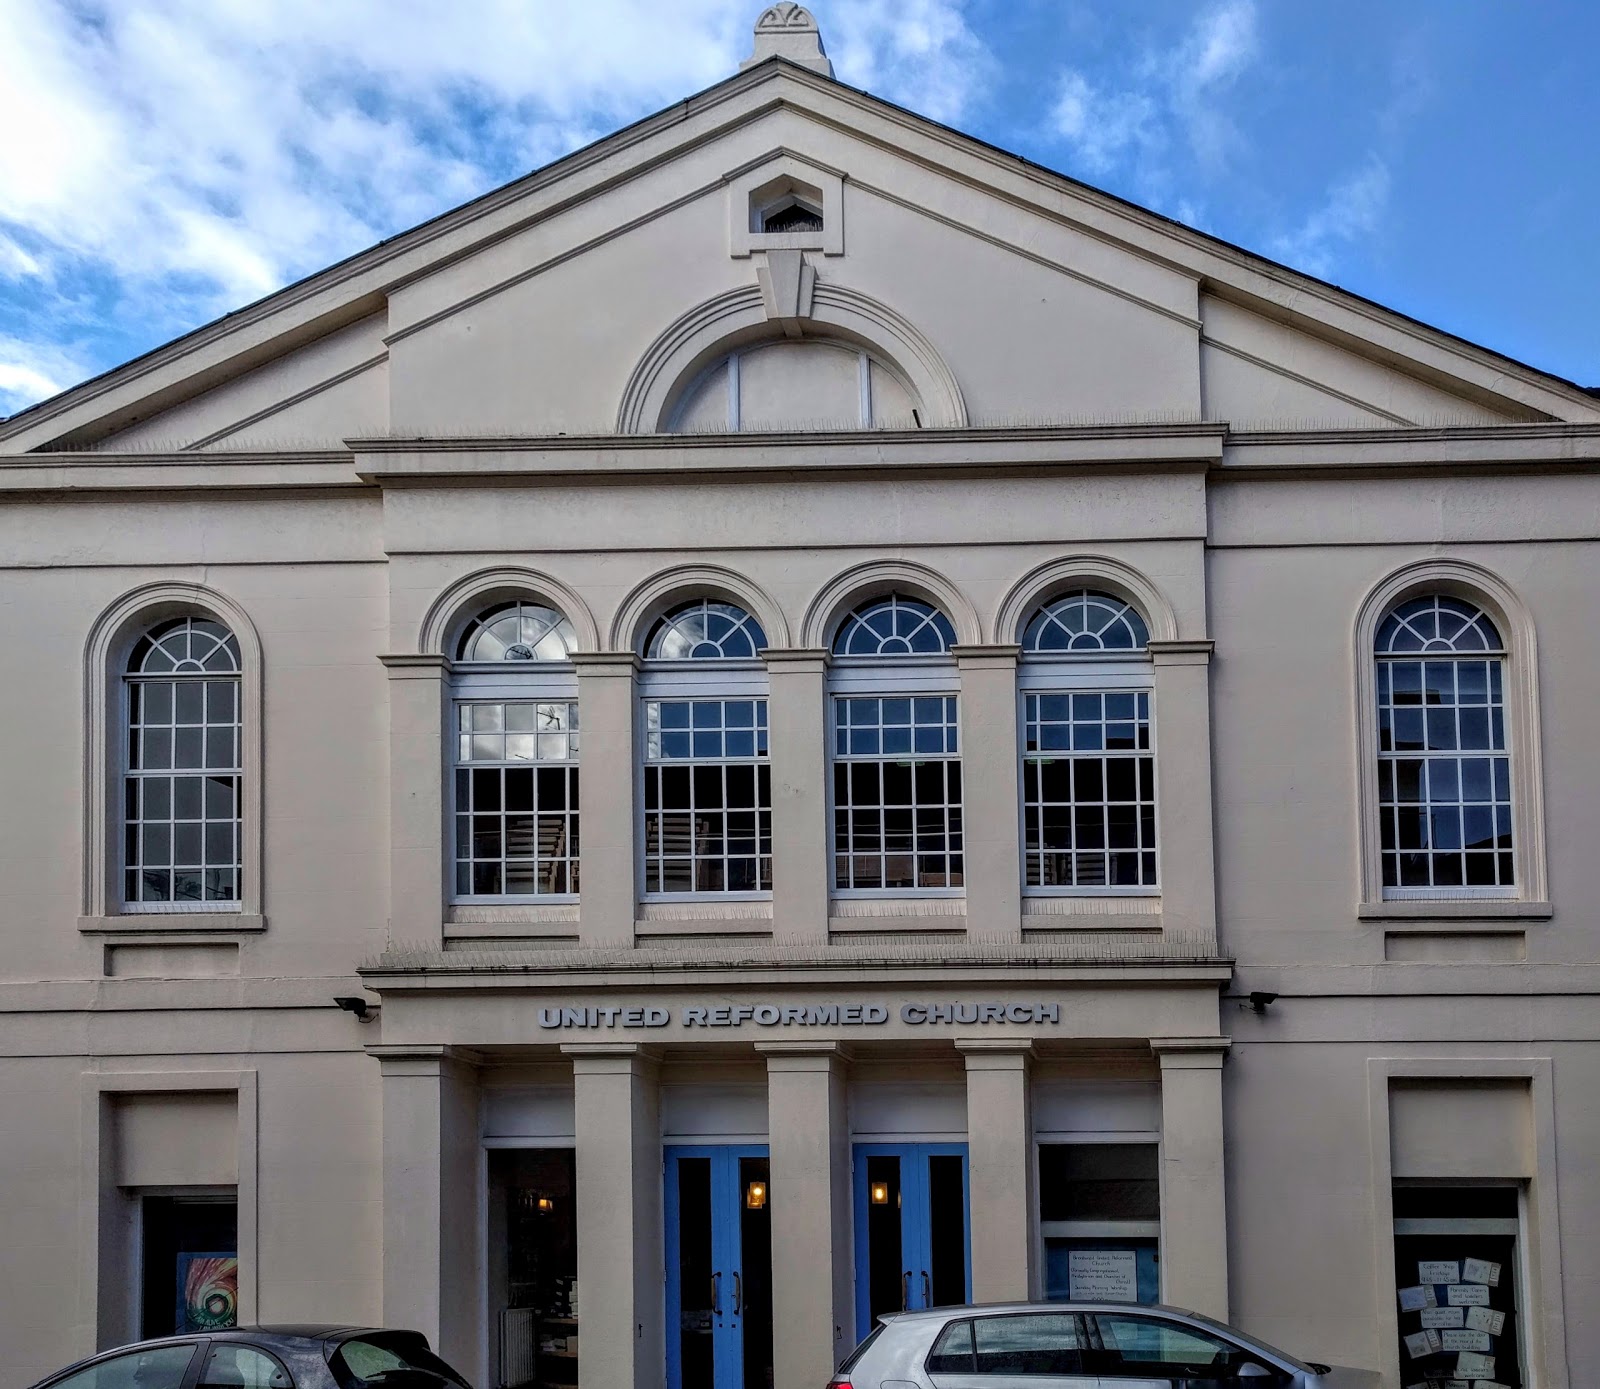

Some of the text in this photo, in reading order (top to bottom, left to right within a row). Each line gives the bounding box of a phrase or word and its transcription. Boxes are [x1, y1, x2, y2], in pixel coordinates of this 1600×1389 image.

[537, 1003, 1060, 1028] UNITED REFORMED CHURCH
[223, 1317, 235, 1327] YOU
